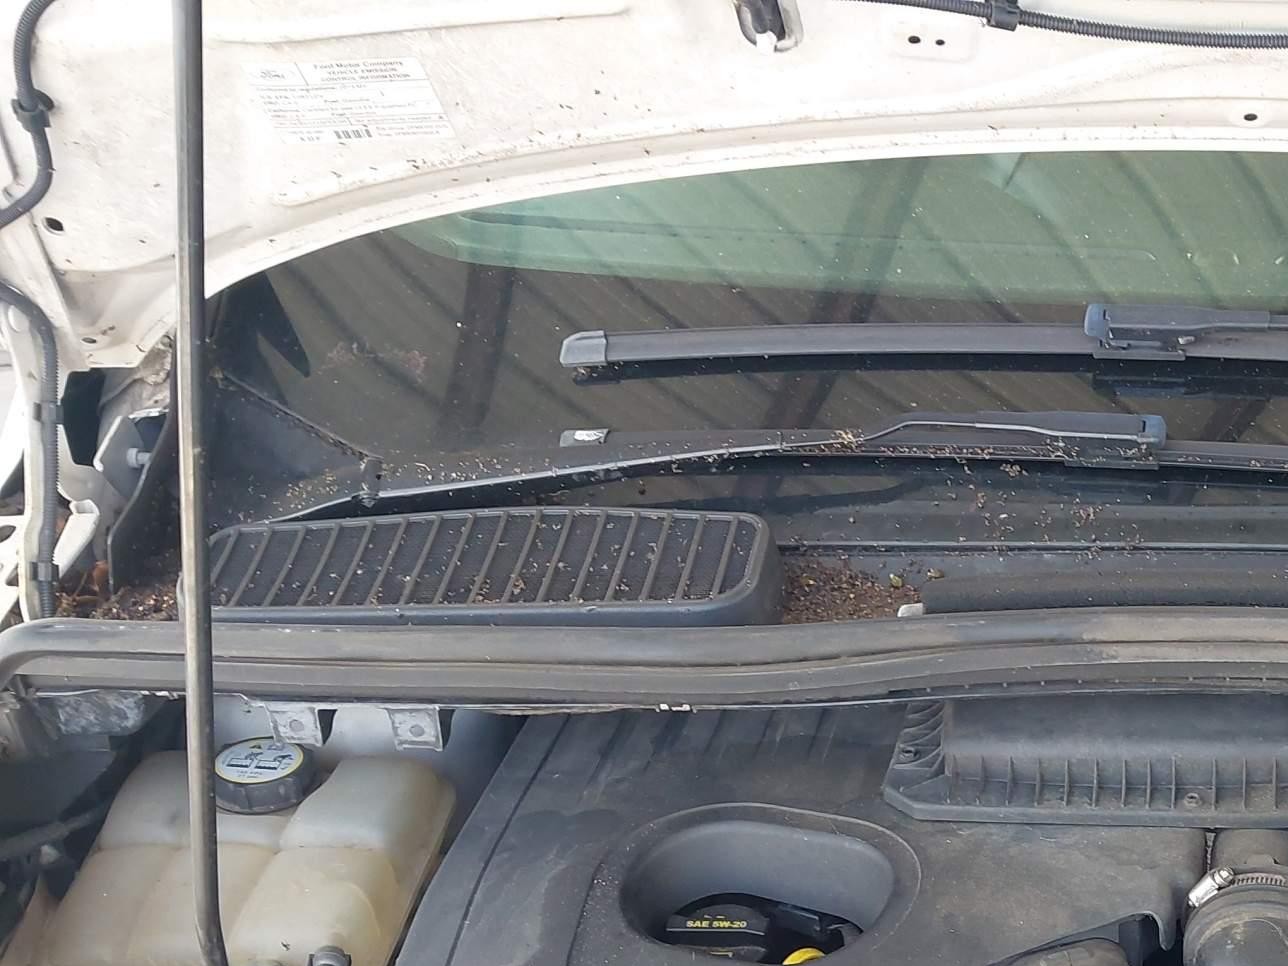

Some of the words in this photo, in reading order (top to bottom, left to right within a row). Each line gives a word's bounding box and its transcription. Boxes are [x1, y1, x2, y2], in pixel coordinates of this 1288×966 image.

[362, 60, 404, 68] Company
[686, 920, 709, 928] SAE
[712, 920, 747, 928] 5W-20
